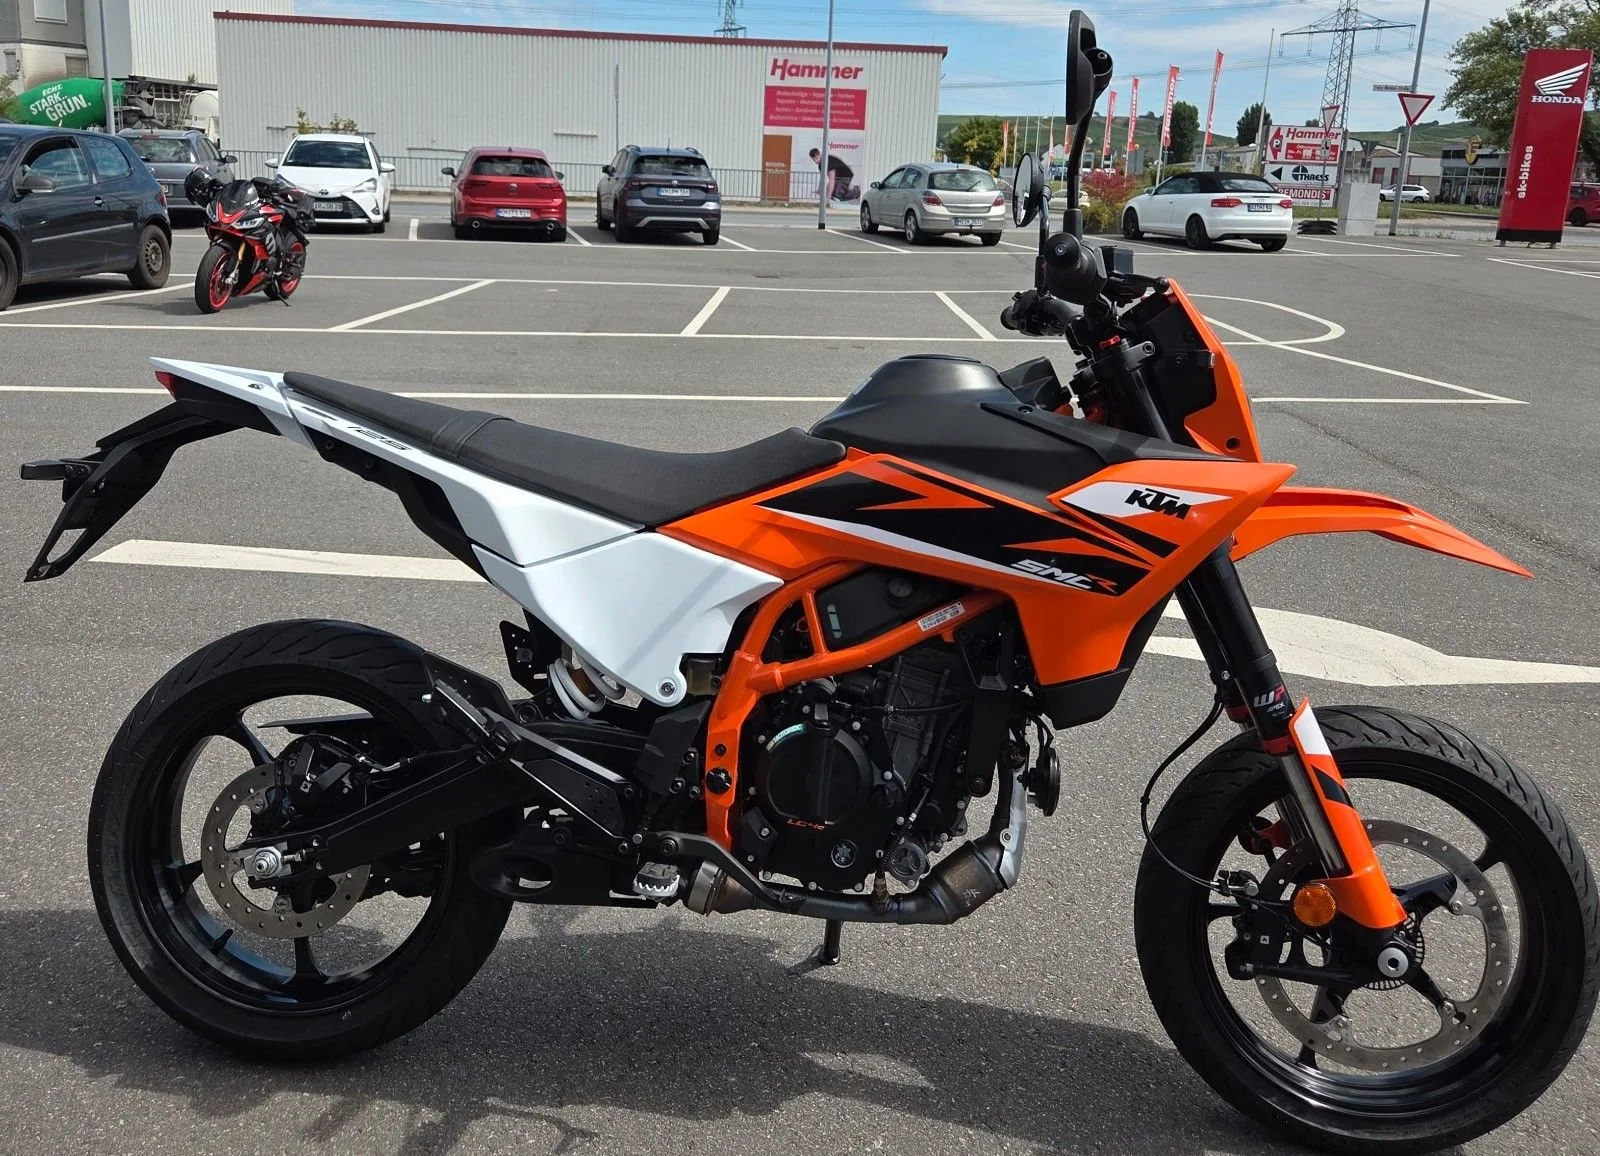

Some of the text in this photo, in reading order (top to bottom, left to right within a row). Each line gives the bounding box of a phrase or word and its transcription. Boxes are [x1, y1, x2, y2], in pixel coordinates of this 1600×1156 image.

[770, 58, 864, 81] Hammer
[1531, 95, 1583, 104] HONDA
[1286, 128, 1341, 140] Hammer
[1516, 145, 1534, 199] ak-bikes
[1125, 488, 1191, 520] KTM
